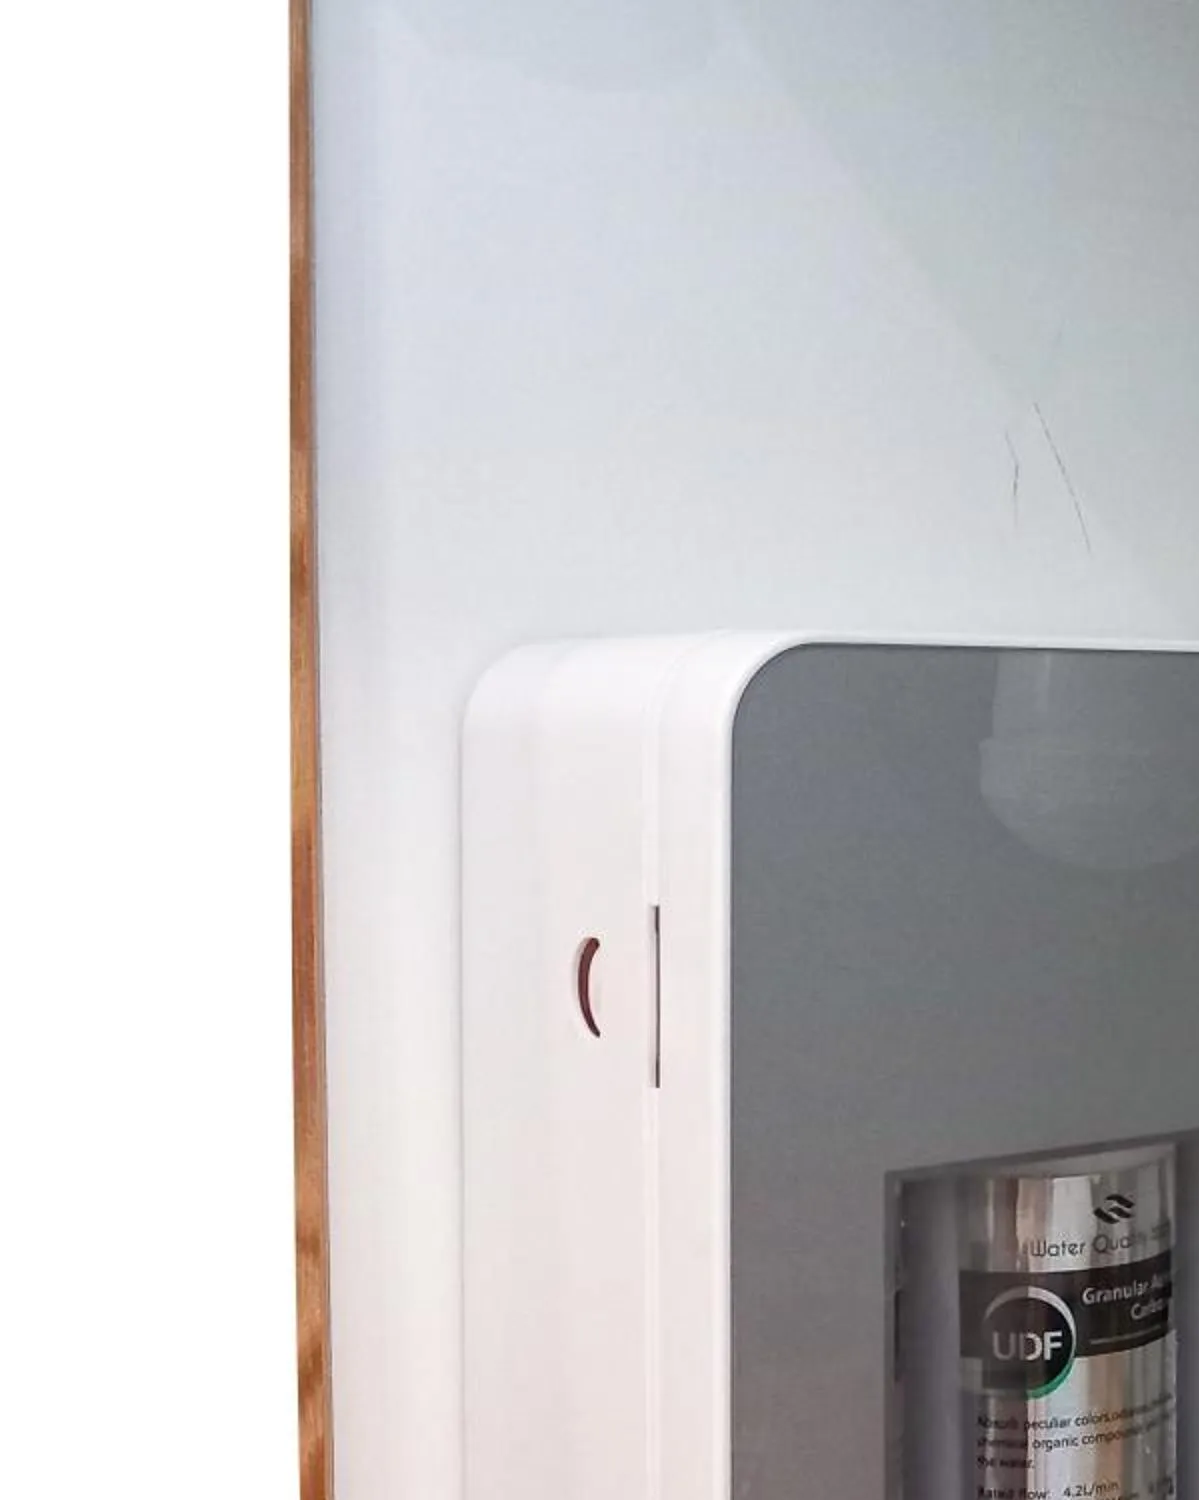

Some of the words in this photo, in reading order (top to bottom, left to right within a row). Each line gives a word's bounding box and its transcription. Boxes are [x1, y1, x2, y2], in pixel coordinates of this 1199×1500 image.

[1031, 1239, 1086, 1258] Water
[1082, 1279, 1150, 1306] Granular
[992, 1330, 1063, 1361] UDF
[1032, 1435, 1078, 1452] organic
